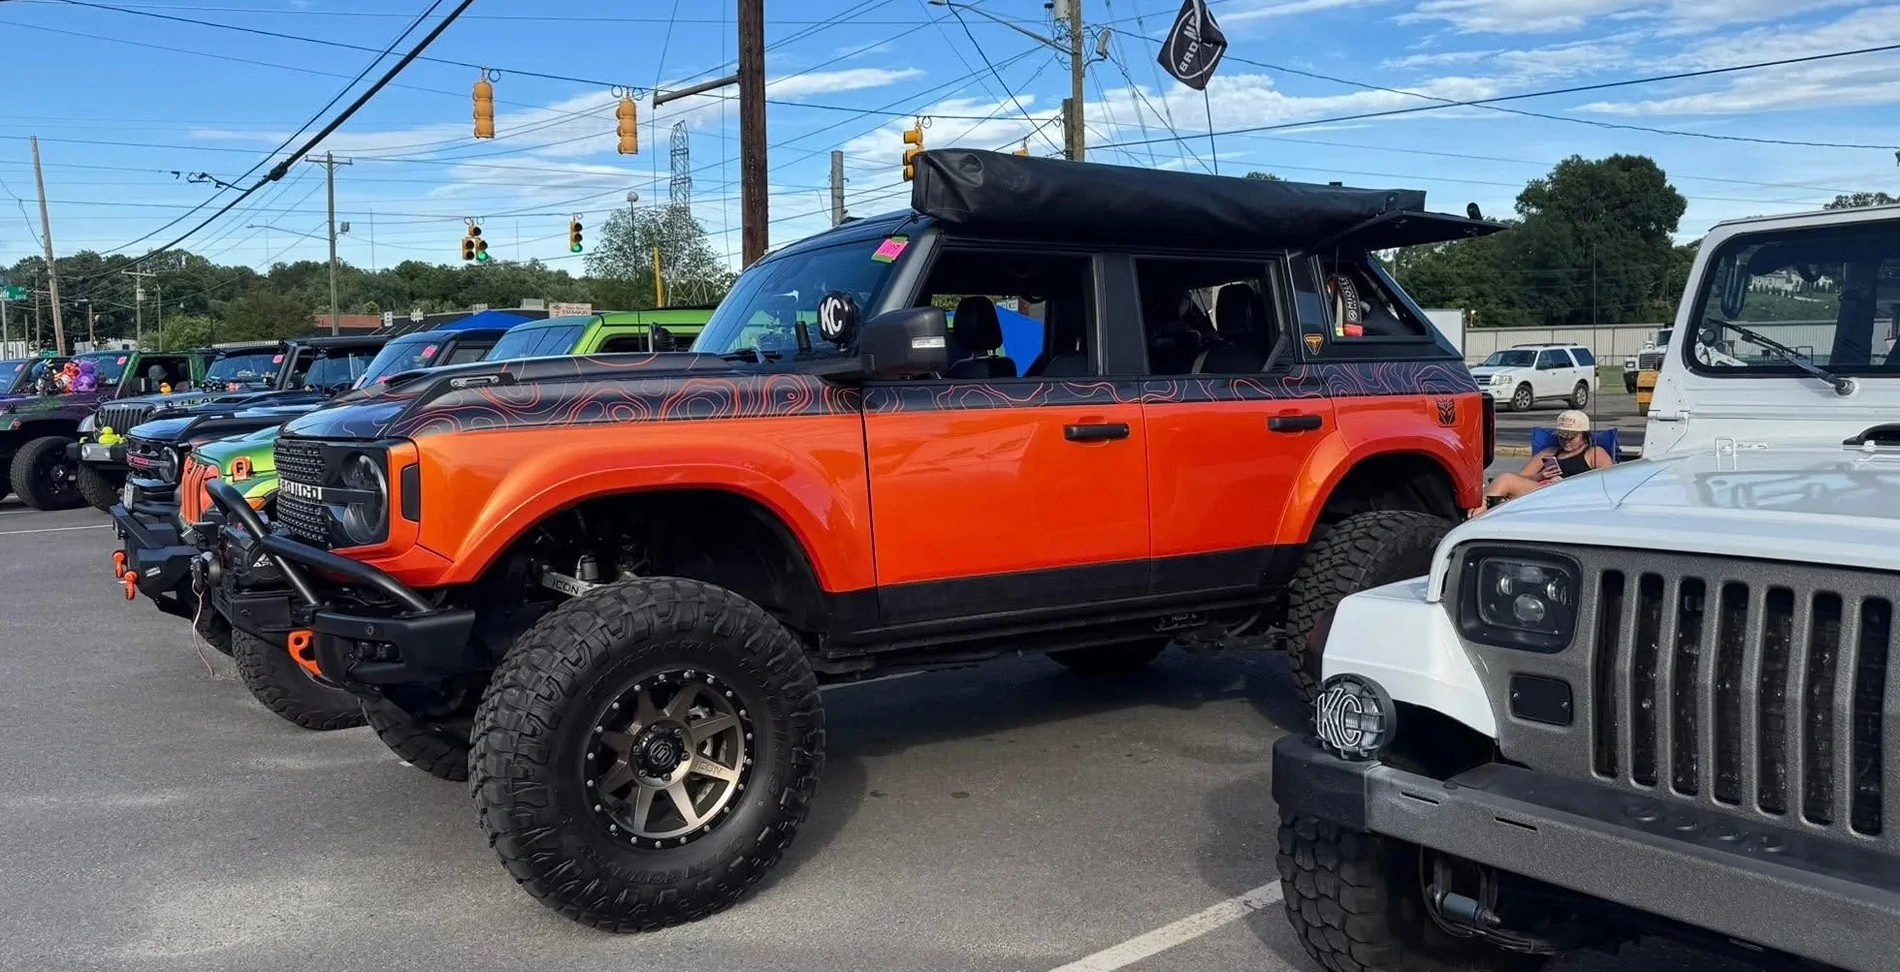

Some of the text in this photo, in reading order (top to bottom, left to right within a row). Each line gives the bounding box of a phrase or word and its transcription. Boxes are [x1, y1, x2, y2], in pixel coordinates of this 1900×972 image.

[820, 297, 843, 335] KC
[551, 579, 580, 595] ICON
[1317, 688, 1362, 748] KC
